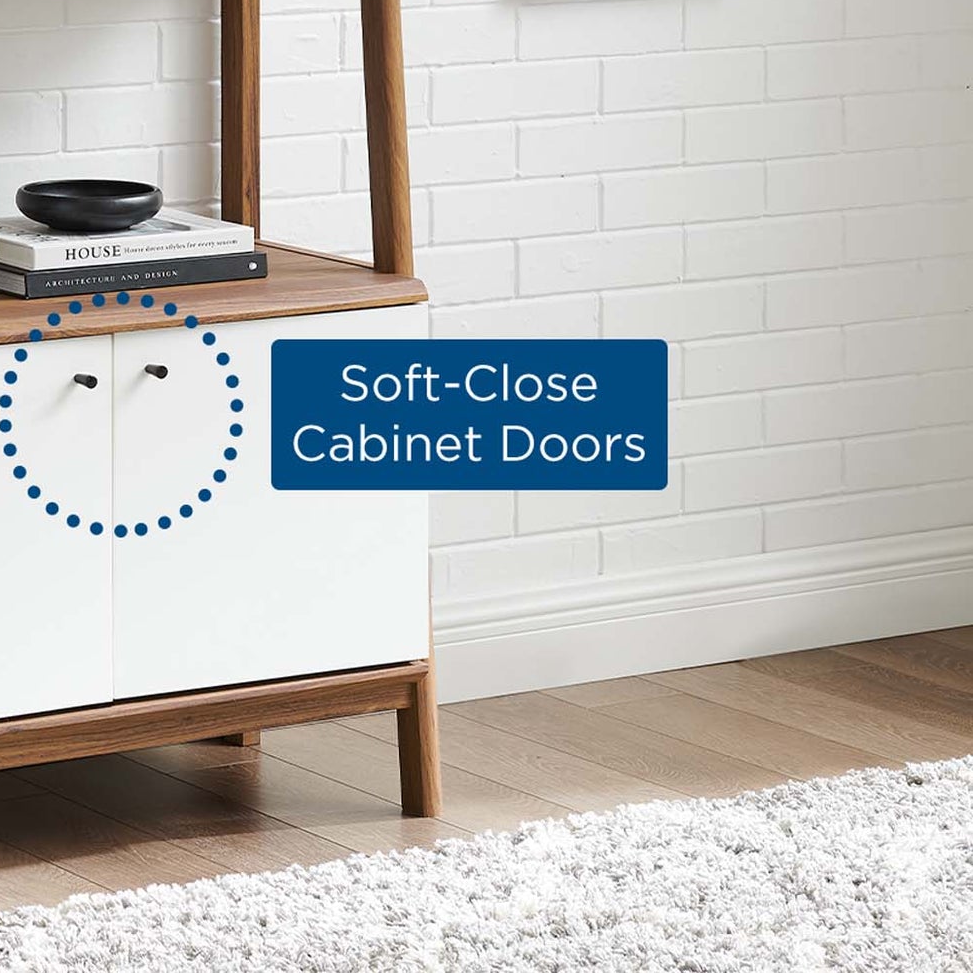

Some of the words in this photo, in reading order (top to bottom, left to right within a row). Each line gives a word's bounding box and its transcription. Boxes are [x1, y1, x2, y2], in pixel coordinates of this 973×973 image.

[65, 244, 122, 261] HOUSE
[45, 276, 116, 287] ARCHITECTURE
[121, 271, 140, 281] AND
[145, 270, 178, 279] DESIGN
